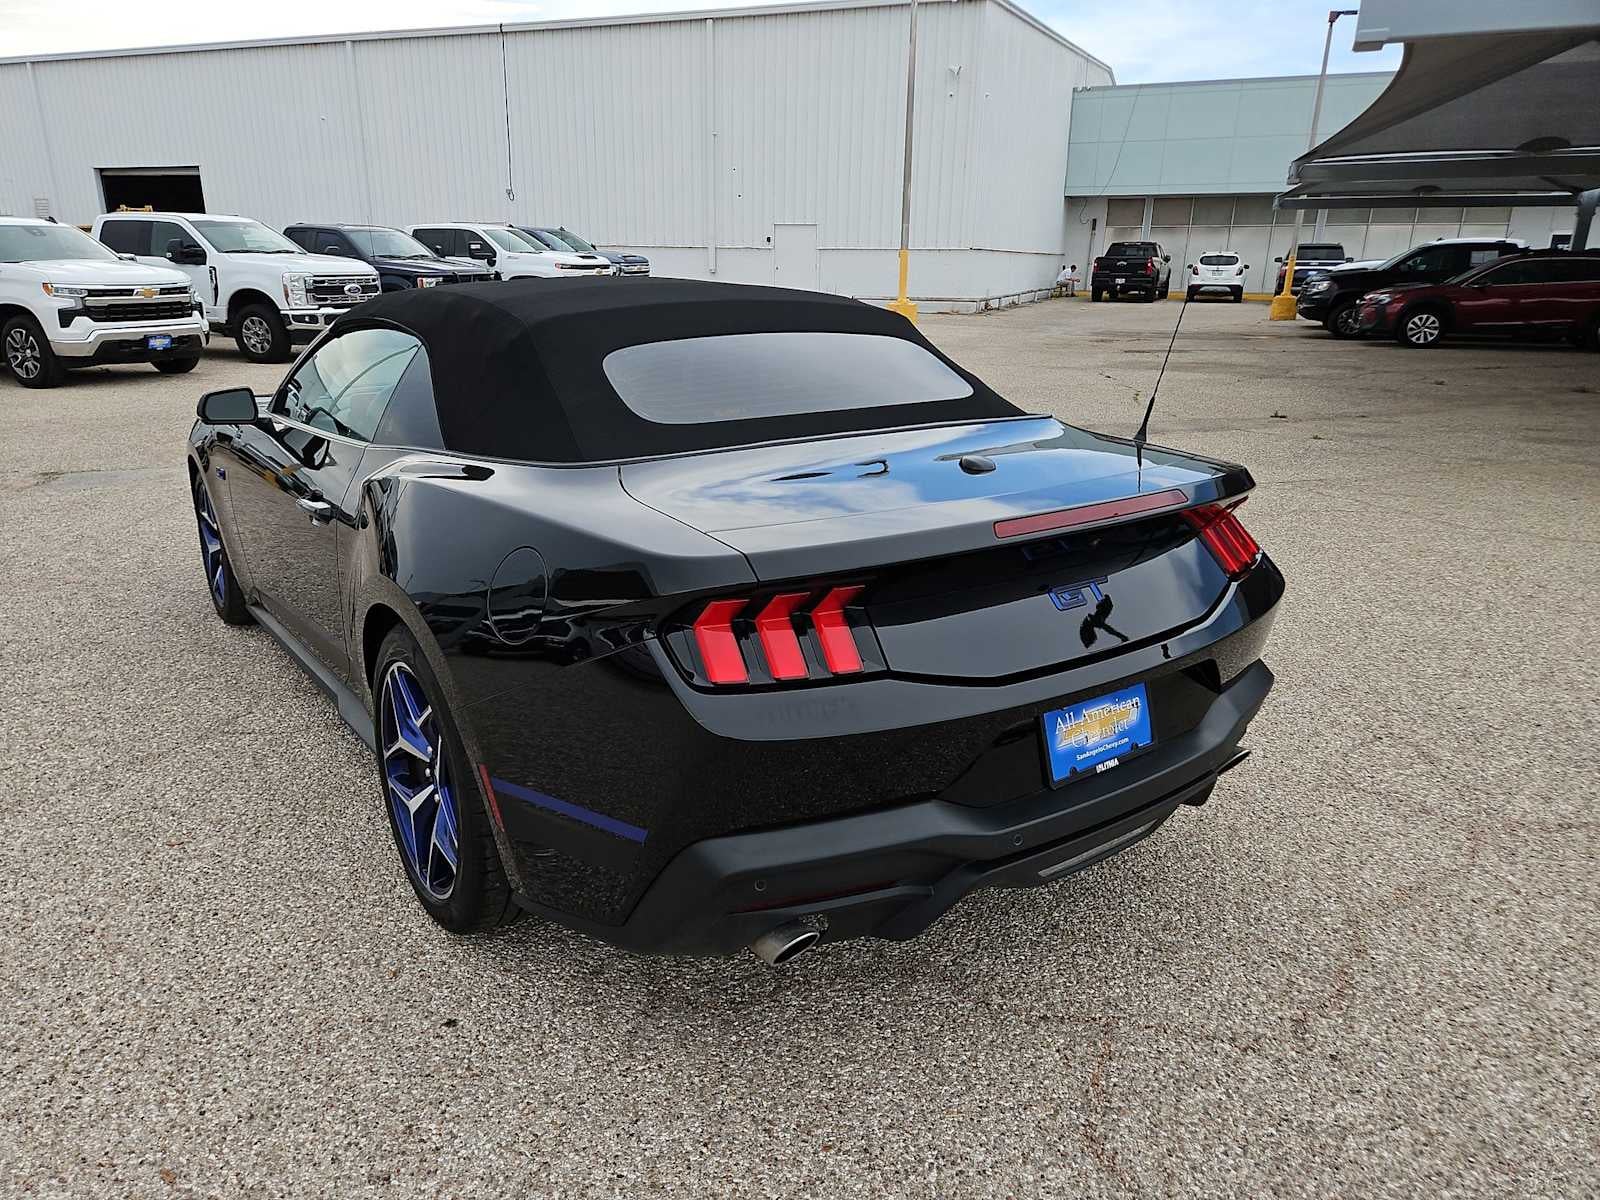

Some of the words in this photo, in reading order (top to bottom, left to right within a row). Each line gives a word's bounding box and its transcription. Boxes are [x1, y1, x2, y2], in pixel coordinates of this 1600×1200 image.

[1048, 576, 1108, 611] GT
[1055, 711, 1075, 735] All
[1081, 696, 1141, 724] American
[1072, 718, 1129, 748] Chevrolet
[1076, 737, 1130, 761] SanAngeloChevy.com
